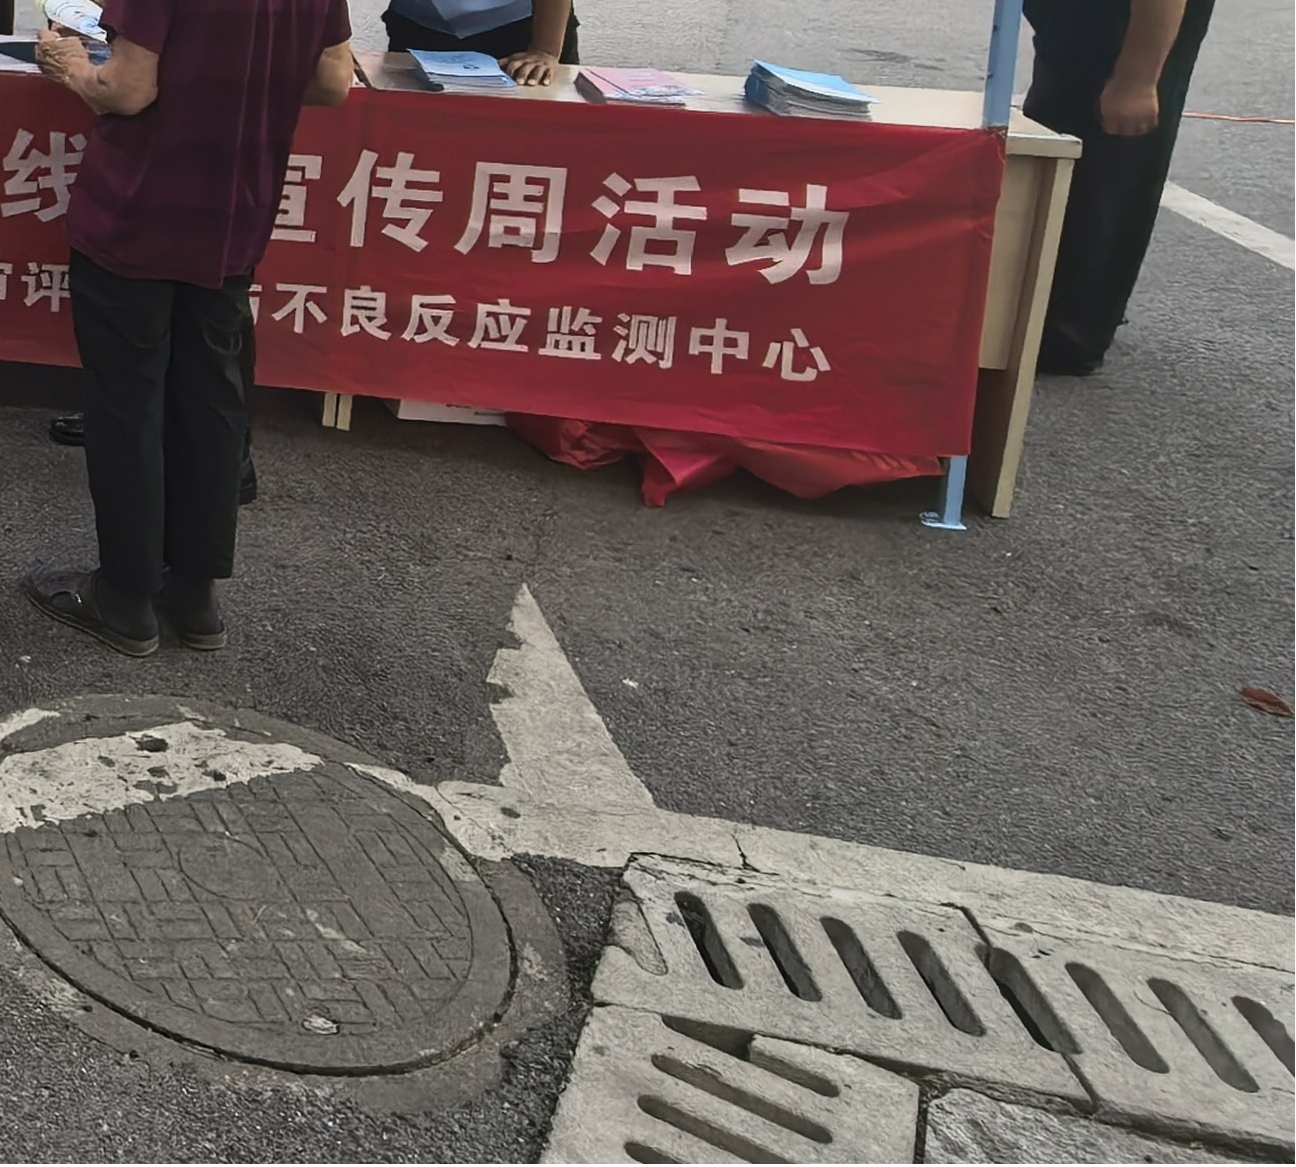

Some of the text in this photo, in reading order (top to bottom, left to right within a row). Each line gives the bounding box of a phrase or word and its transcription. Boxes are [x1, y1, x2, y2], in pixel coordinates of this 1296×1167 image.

[249, 283, 832, 384] 不良反应监测中心
